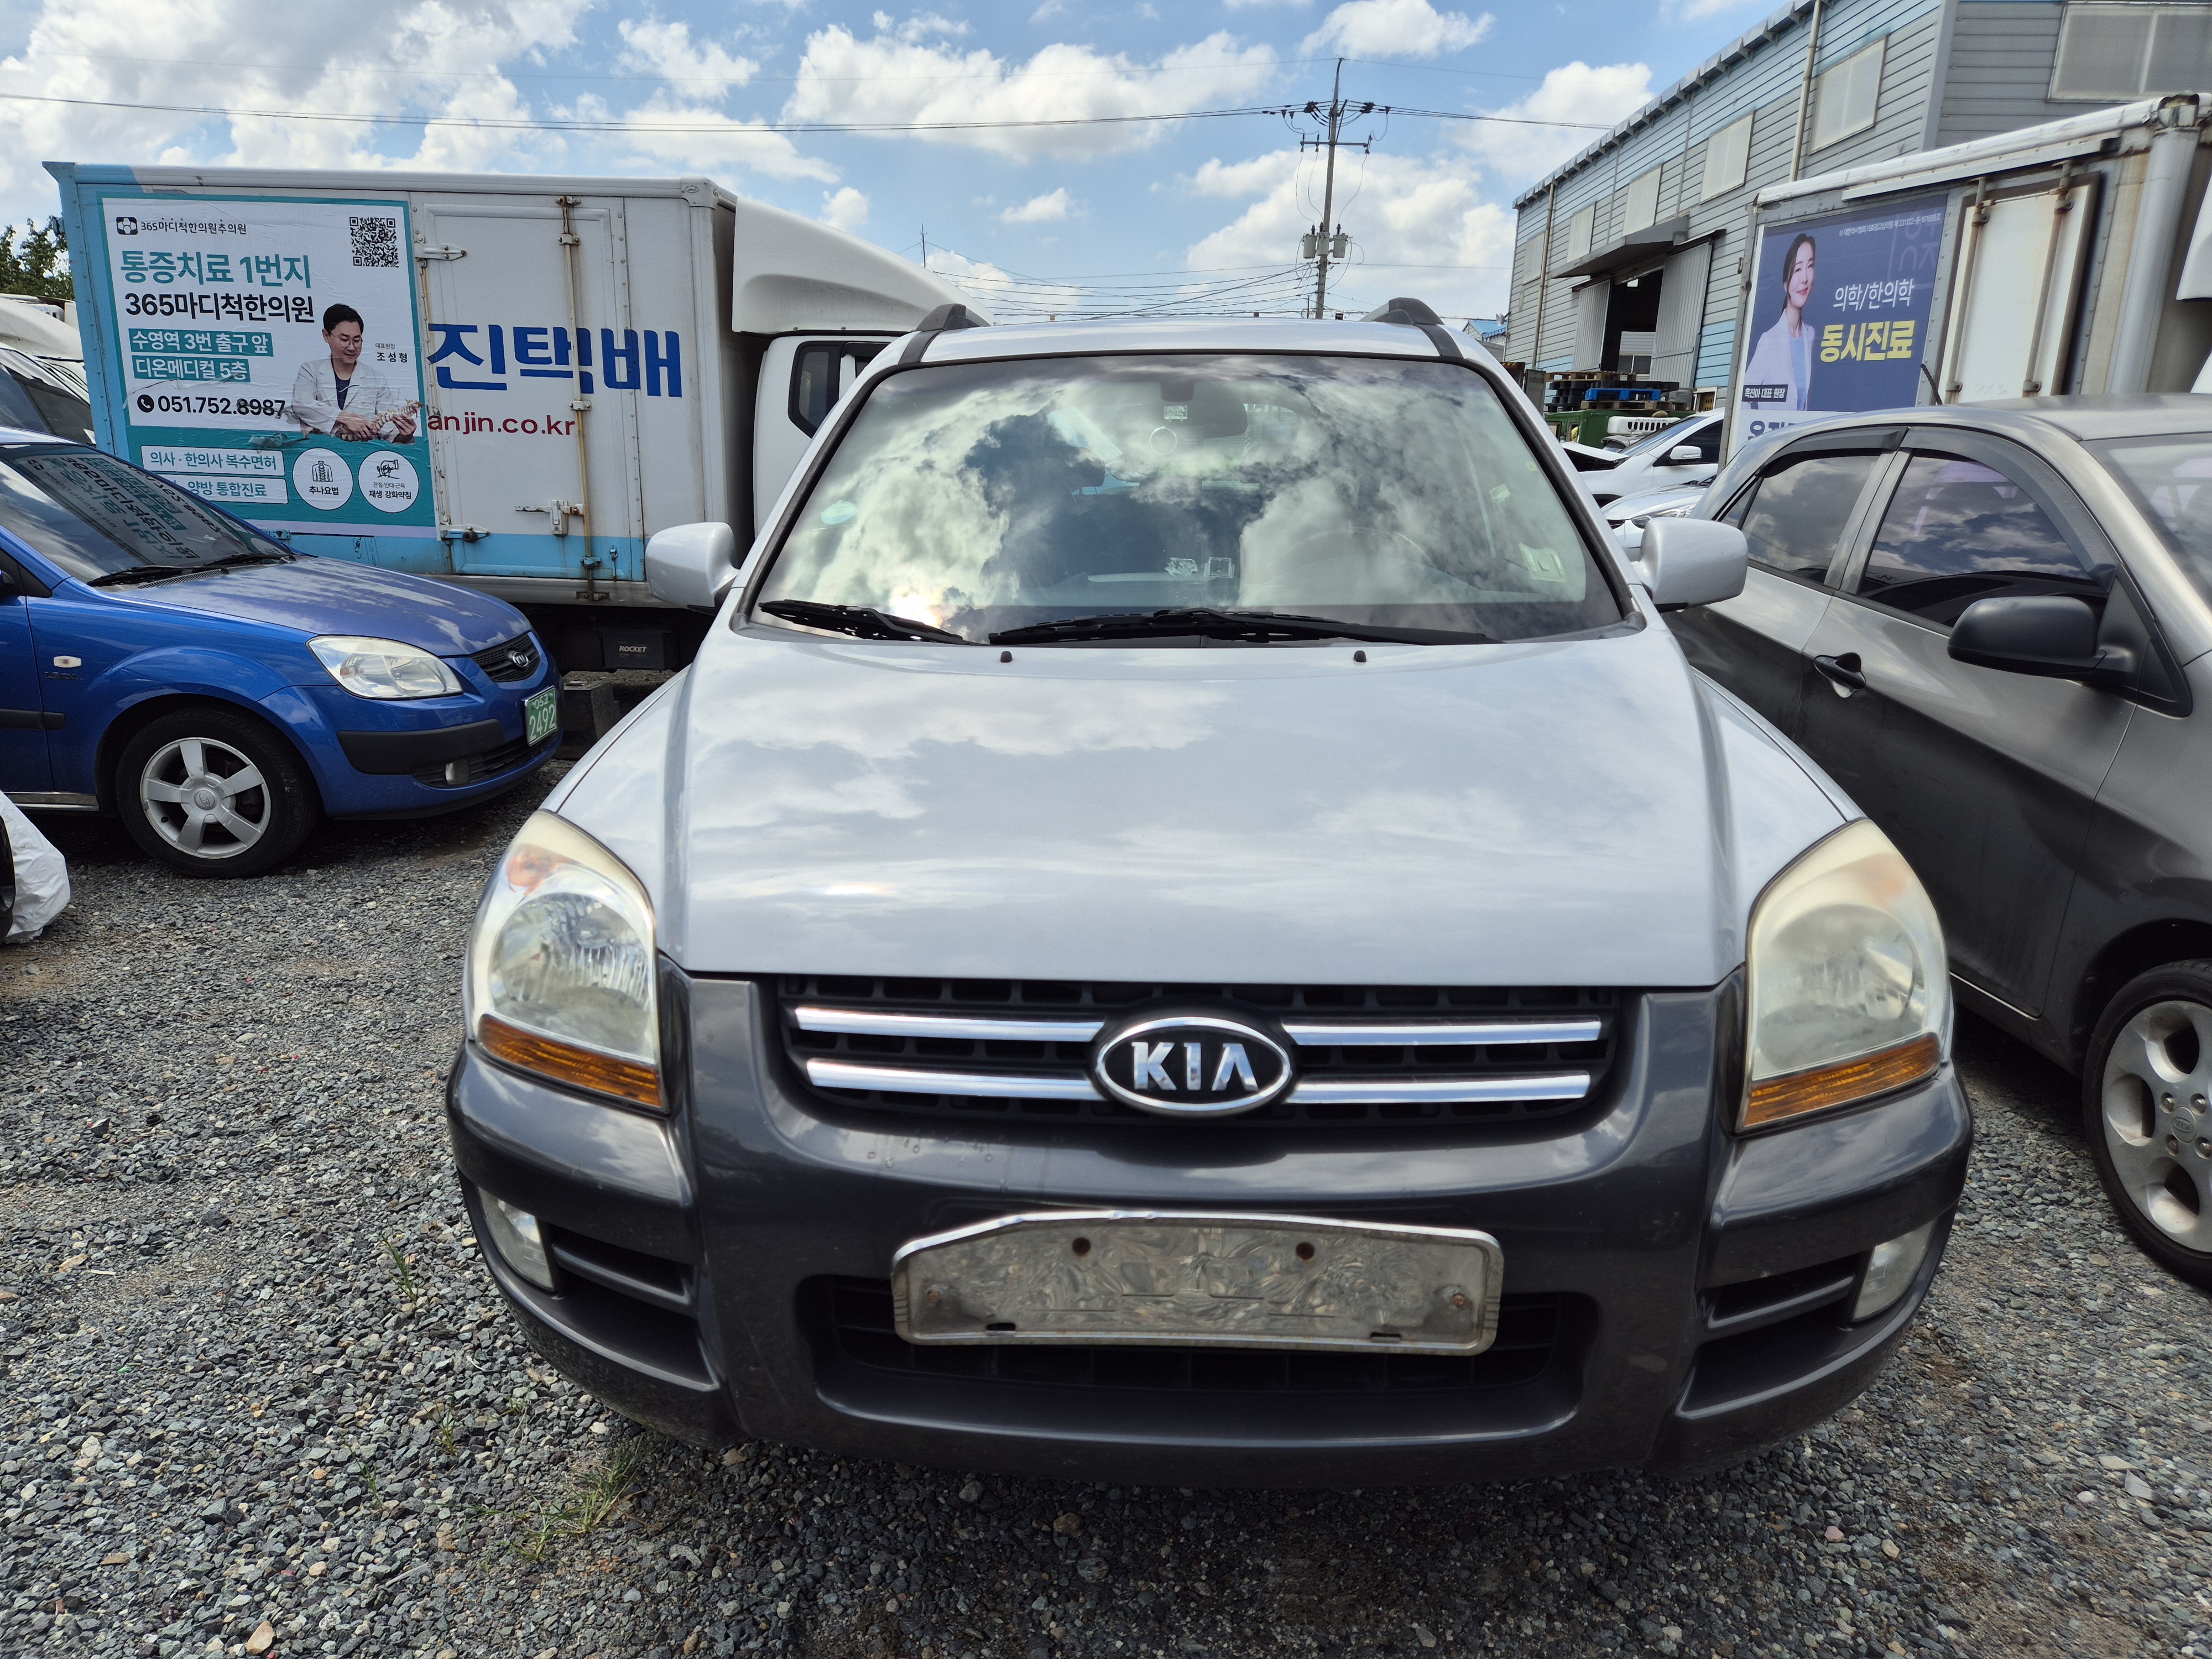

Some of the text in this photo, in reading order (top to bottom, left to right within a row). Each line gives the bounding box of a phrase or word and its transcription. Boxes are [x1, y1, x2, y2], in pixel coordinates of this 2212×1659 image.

[140, 218, 247, 234] 365마디척한의원추의원
[121, 251, 311, 289] 통증치료 1번지
[1833, 278, 1914, 312] 의학/한의학
[124, 292, 315, 324] 365마디척한의원
[132, 331, 269, 354] 수영역 3번 출구 앞
[1820, 320, 1916, 363] 동시진료
[135, 358, 248, 380] 디온메디컬 5층
[426, 323, 683, 398] 진택배
[1744, 388, 1786, 399] 옥진아 대표 원장
[158, 395, 286, 419] 051.752.8987
[427, 411, 576, 436] anjin.co.kr
[150, 451, 176, 467] 의사
[184, 452, 223, 468] 한의사
[226, 454, 277, 471] 복수면허
[188, 481, 267, 497] 양방 통합진료
[309, 486, 339, 495] 추나요법
[369, 489, 411, 499] 재생 강화약침
[529, 703, 556, 742] 2492
[1131, 1041, 1259, 1092] KIA
